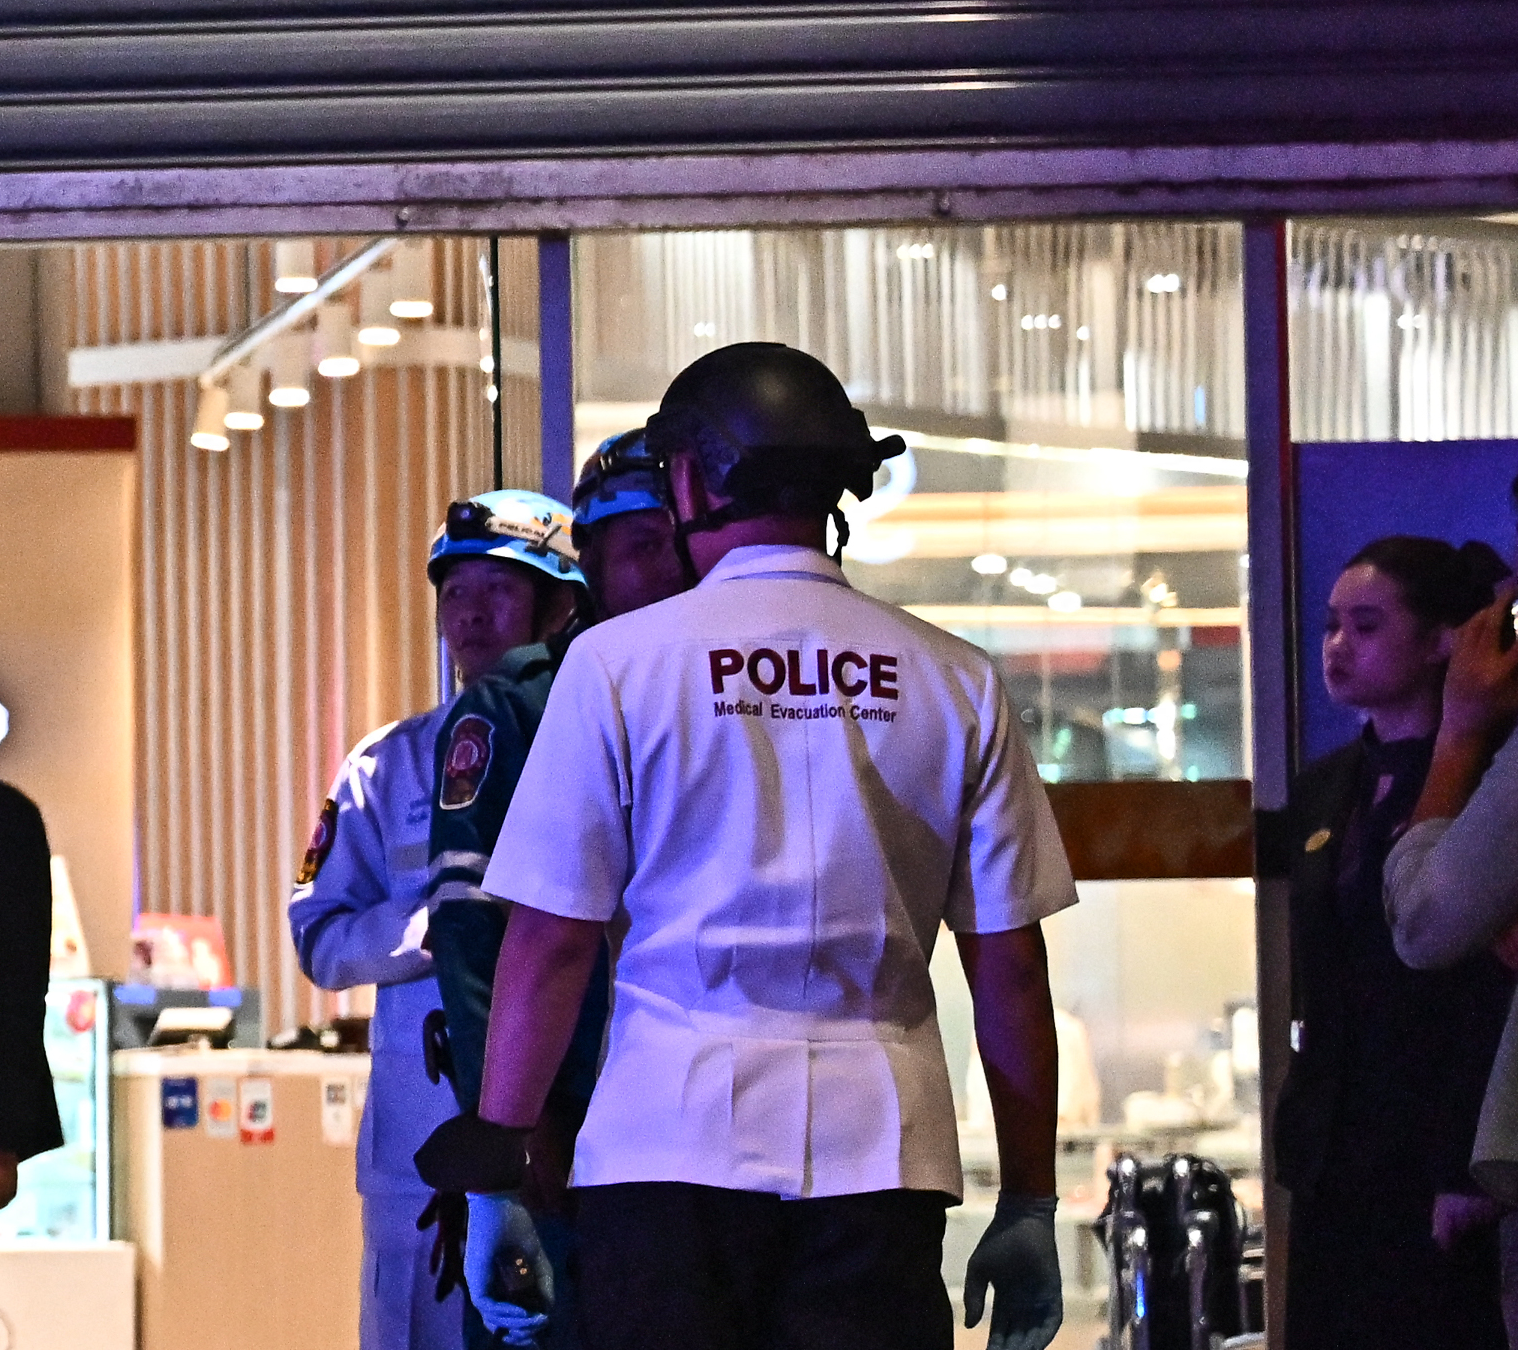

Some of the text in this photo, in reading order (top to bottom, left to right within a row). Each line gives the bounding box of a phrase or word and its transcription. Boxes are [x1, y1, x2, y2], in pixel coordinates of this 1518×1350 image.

[709, 647, 899, 701] POLICE
[714, 701, 897, 724] Medical Evacuation Center
